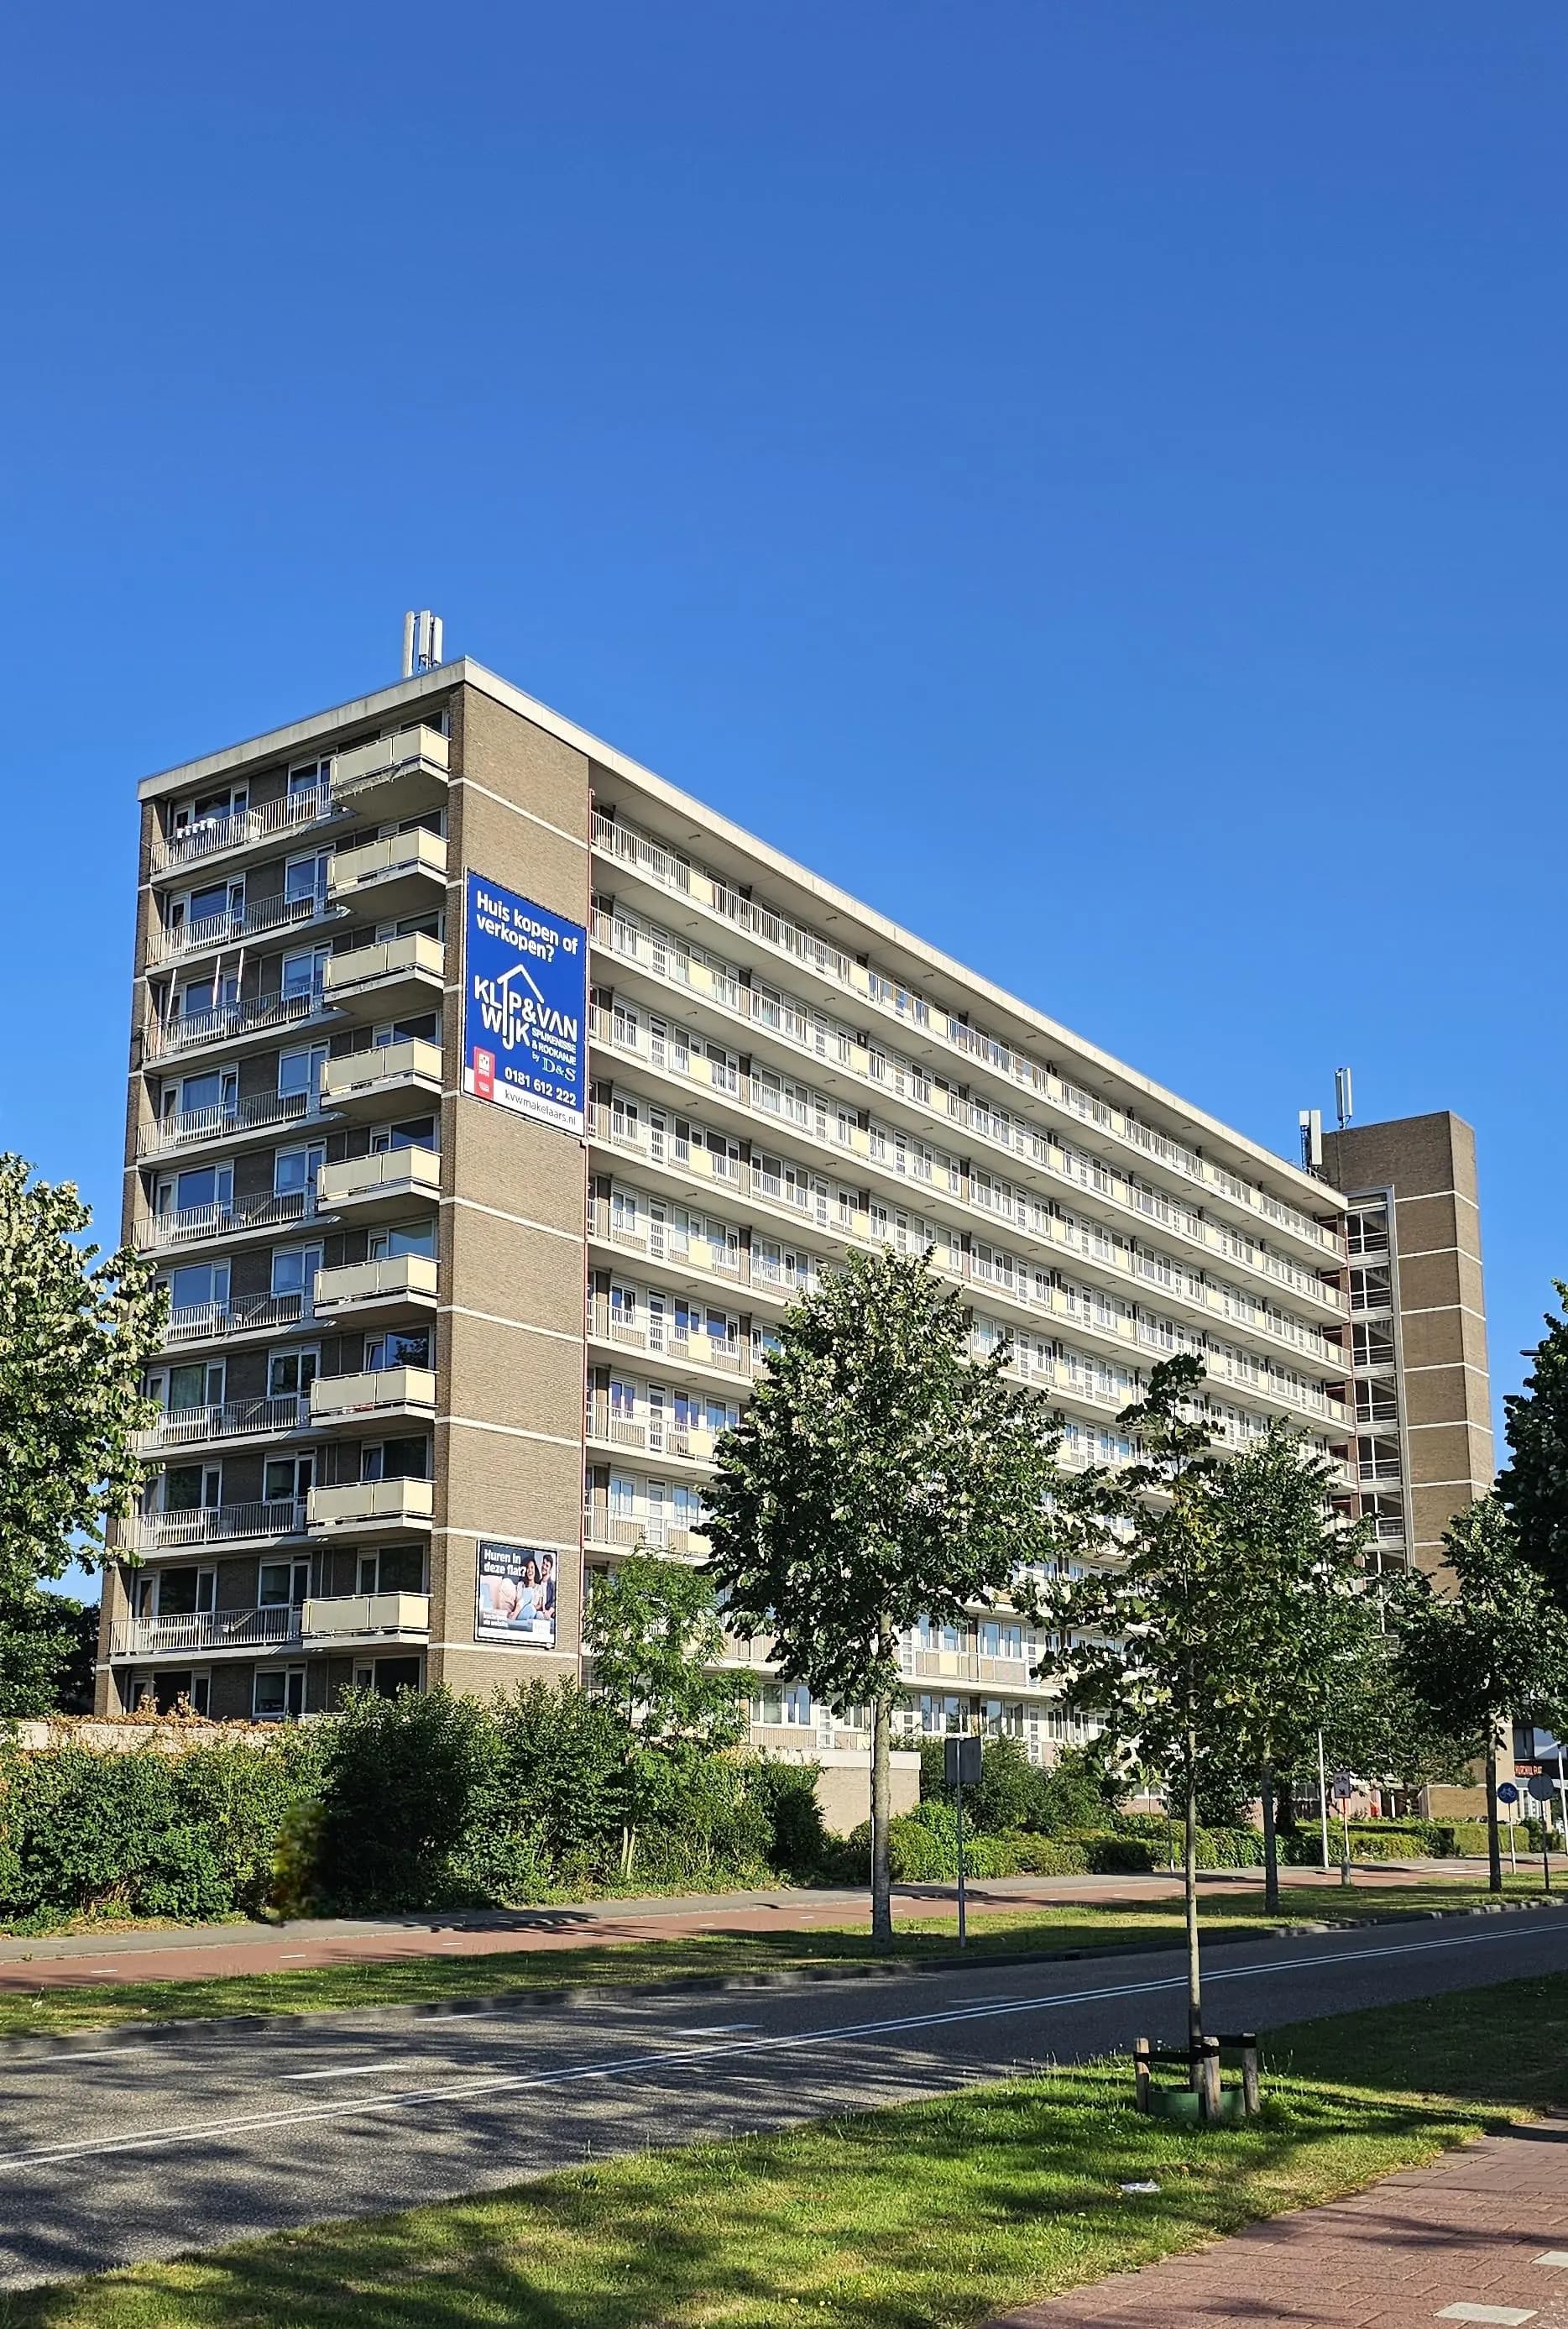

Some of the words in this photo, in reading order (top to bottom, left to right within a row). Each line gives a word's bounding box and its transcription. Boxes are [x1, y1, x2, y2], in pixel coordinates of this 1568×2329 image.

[476, 913, 555, 963] verkopen?
[477, 890, 510, 922] Huis
[514, 908, 559, 947] kopen
[562, 937, 578, 955] of
[531, 1051, 540, 1062] by
[504, 1066, 531, 1088] 0181
[534, 1079, 553, 1098] 612
[556, 1087, 577, 1107] 222
[504, 1090, 576, 1126] kvwmakelaars.nl
[483, 1548, 511, 1562] Huren
[483, 1561, 506, 1574] deze
[506, 1565, 527, 1578] flat?
